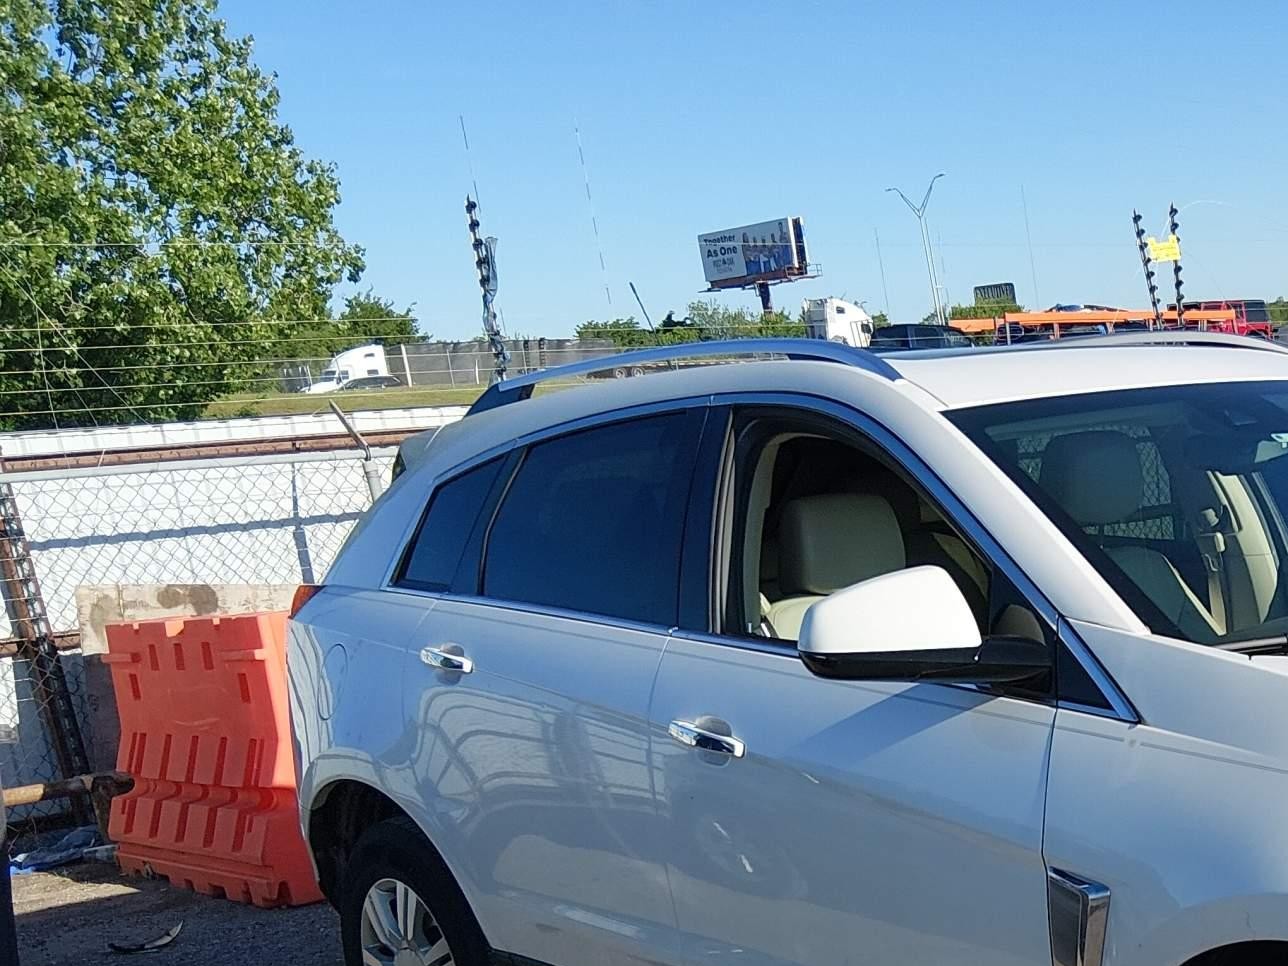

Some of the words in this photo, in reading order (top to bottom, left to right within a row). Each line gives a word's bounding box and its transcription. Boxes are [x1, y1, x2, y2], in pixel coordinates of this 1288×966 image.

[704, 235, 735, 246] Together
[707, 249, 719, 259] As
[719, 246, 737, 256] One
